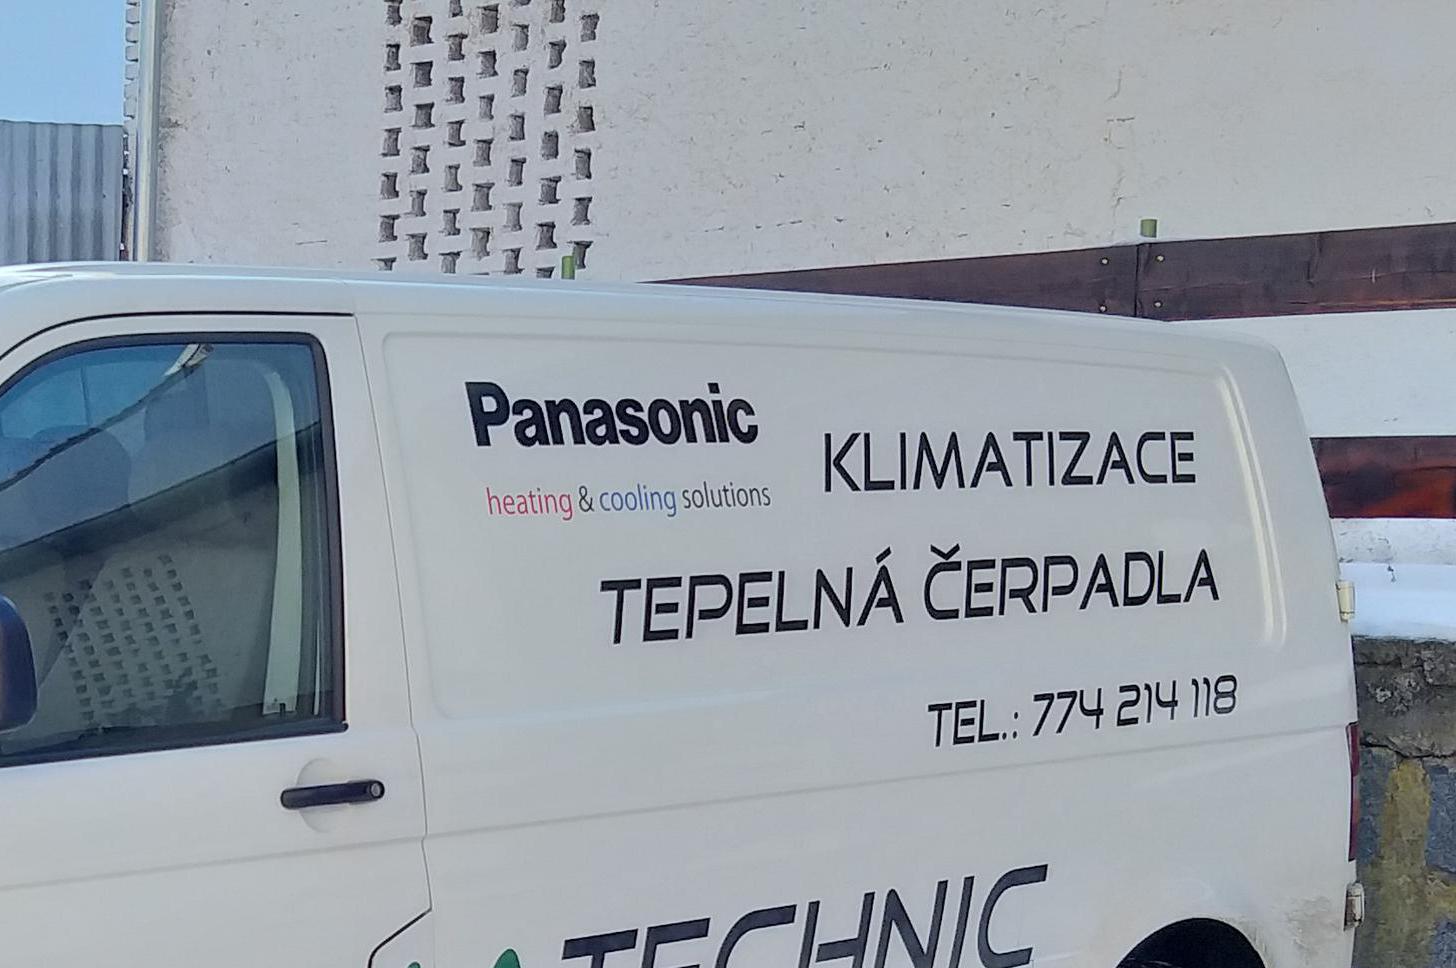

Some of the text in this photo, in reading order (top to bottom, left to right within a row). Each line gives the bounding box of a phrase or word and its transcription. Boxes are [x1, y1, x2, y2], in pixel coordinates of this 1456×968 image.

[464, 381, 759, 448] Panasonic
[823, 431, 1197, 493] KLIMATIZACE
[486, 480, 772, 521] heating & cooling solutions
[599, 543, 1220, 645] TEPELNÁ ČERPADLA
[928, 674, 1238, 748] TEL.: 774 214 118
